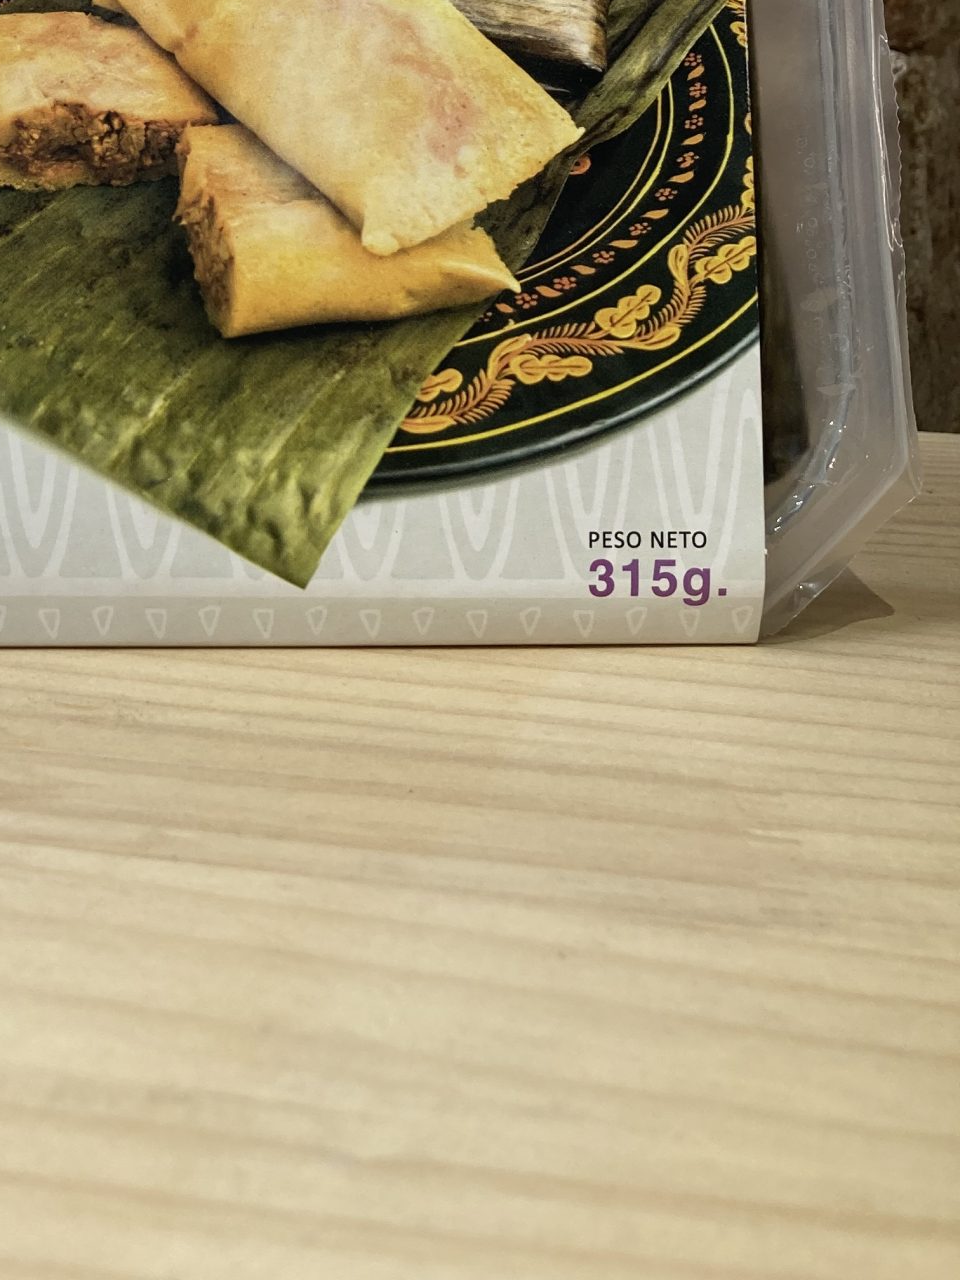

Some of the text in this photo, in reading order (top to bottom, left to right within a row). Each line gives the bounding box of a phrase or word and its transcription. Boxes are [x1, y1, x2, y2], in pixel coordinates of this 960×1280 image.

[588, 531, 707, 549] PESO NETO
[588, 558, 728, 607] 315g.
